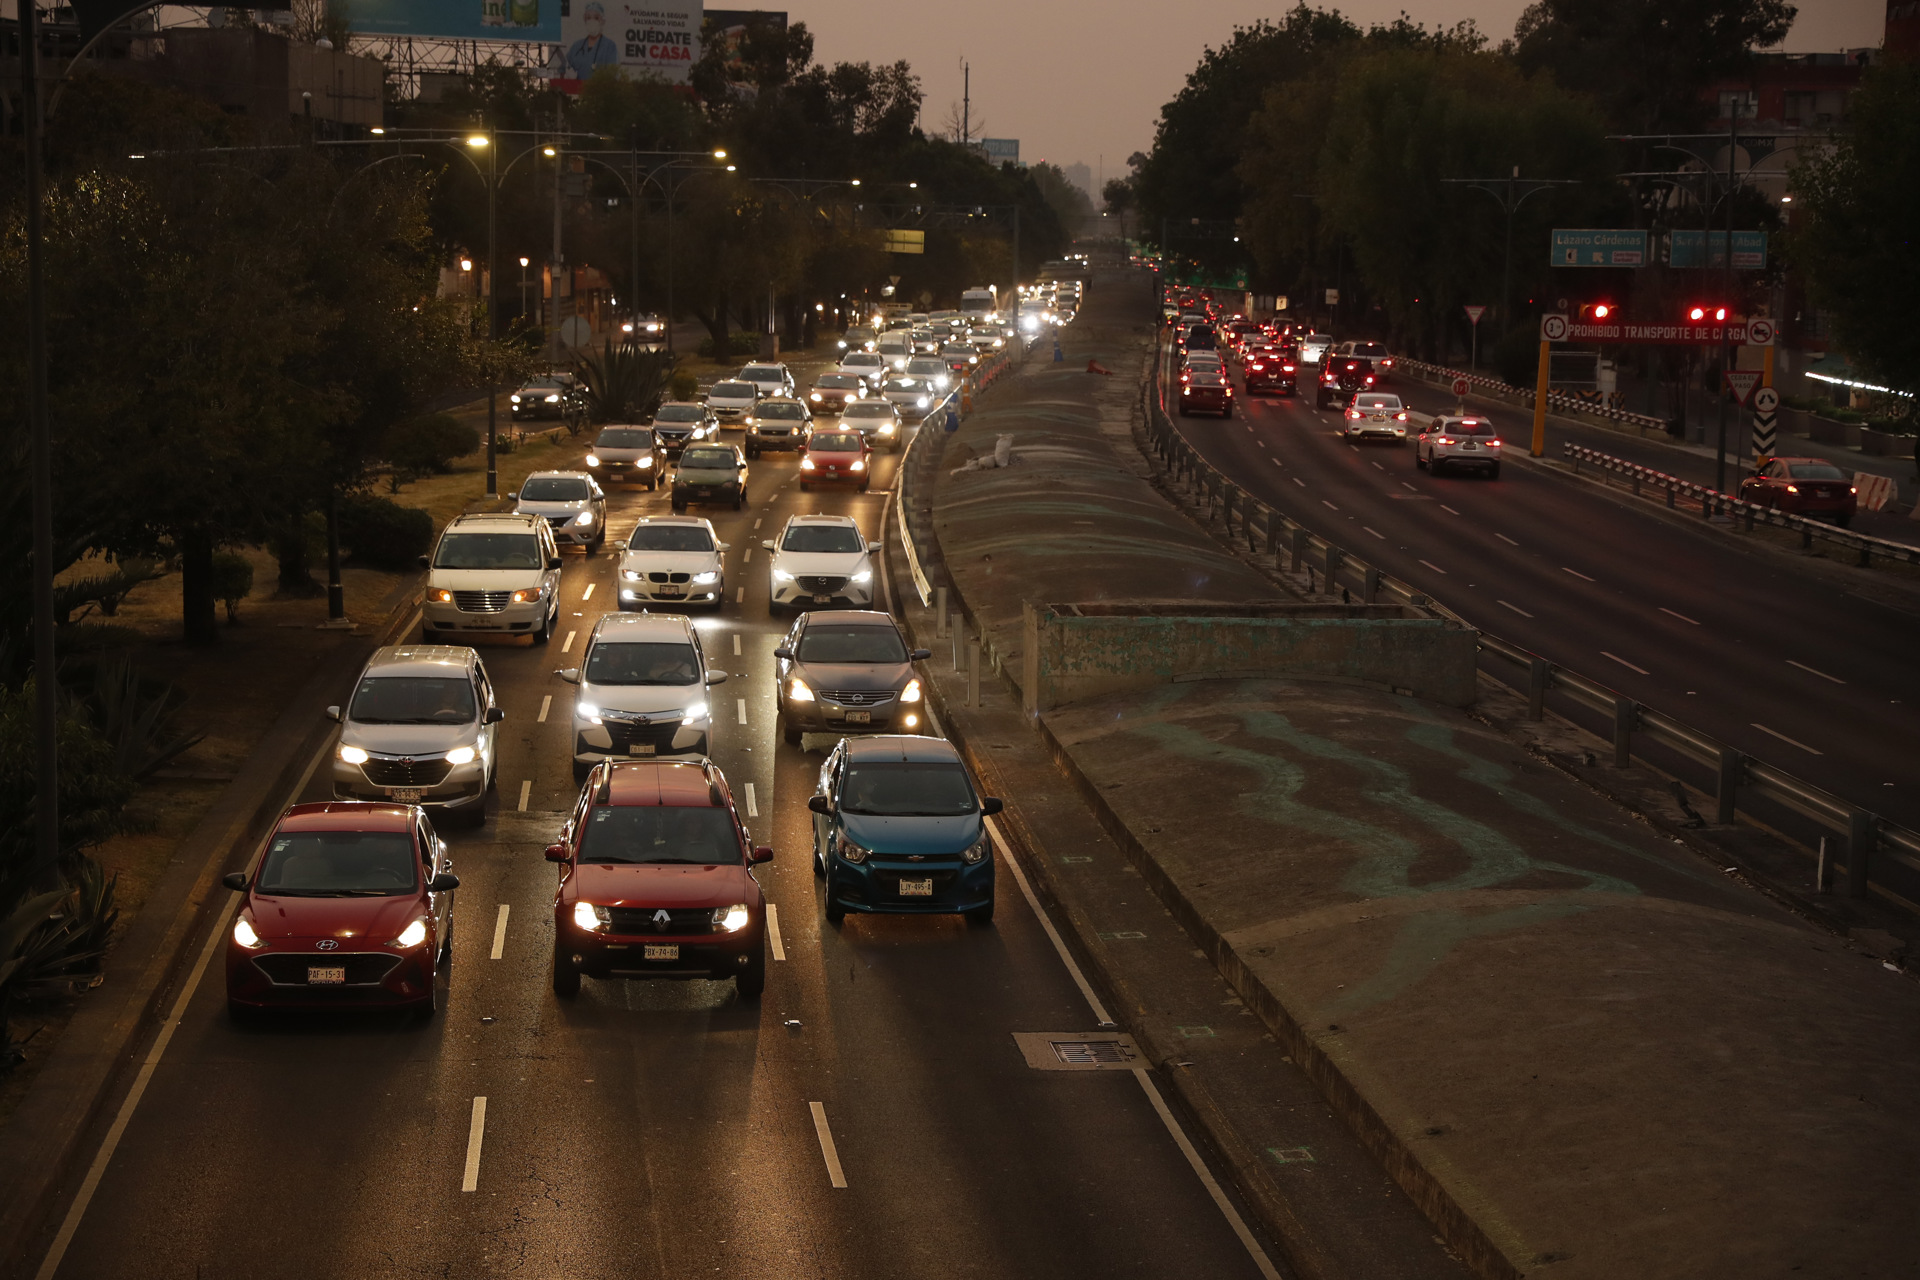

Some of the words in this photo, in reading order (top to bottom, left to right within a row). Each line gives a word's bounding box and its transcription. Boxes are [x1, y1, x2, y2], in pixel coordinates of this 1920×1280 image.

[633, 18, 666, 26] SALVANDO
[625, 27, 691, 45] QUÉDATE
[625, 43, 646, 58] EN
[649, 45, 692, 60] CASA
[1556, 234, 1592, 245] Lázaro
[1593, 234, 1641, 246] Cárdenas
[1736, 237, 1762, 247] Abad
[1567, 324, 1620, 338] PROHIBIDO
[1624, 325, 1691, 340] TRANSPORTE
[1695, 327, 1709, 340] DE
